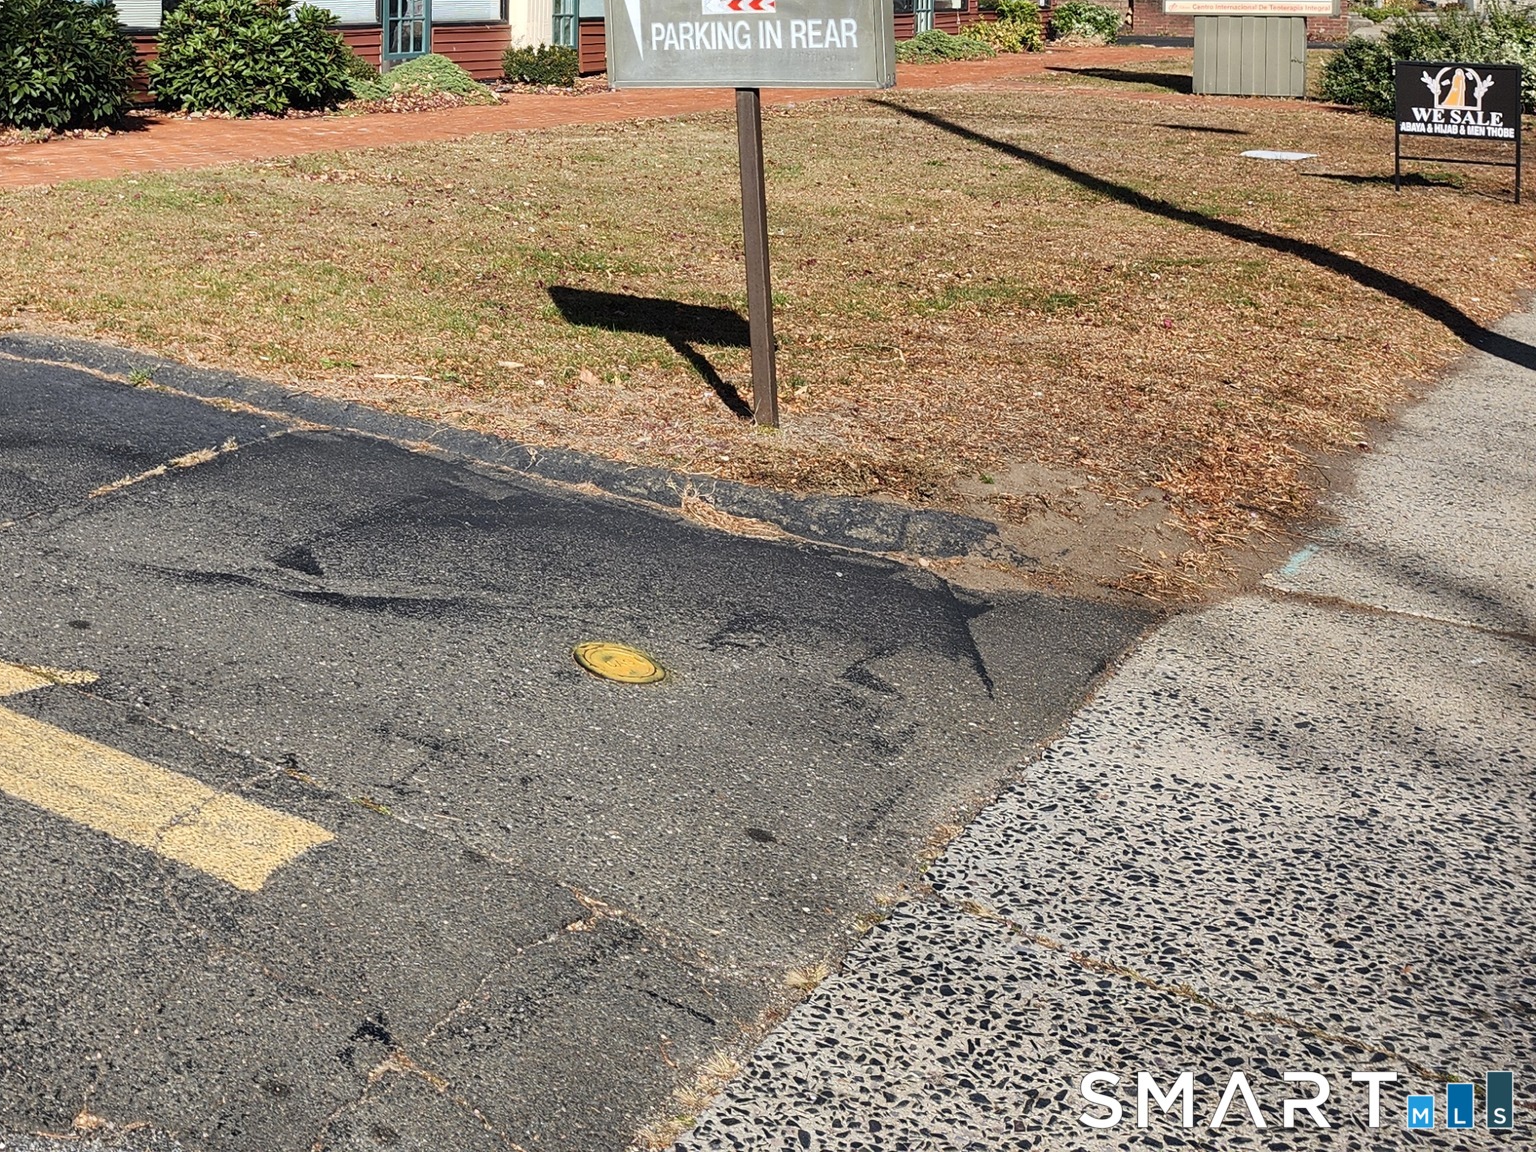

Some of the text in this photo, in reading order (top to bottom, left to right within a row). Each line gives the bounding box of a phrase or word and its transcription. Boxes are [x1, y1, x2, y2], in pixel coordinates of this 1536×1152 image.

[651, 18, 858, 50] PARKING IN REAR
[1412, 108, 1504, 126] WE SALE
[1400, 122, 1515, 138] ABAYA & HIJAB & MEN THOBE
